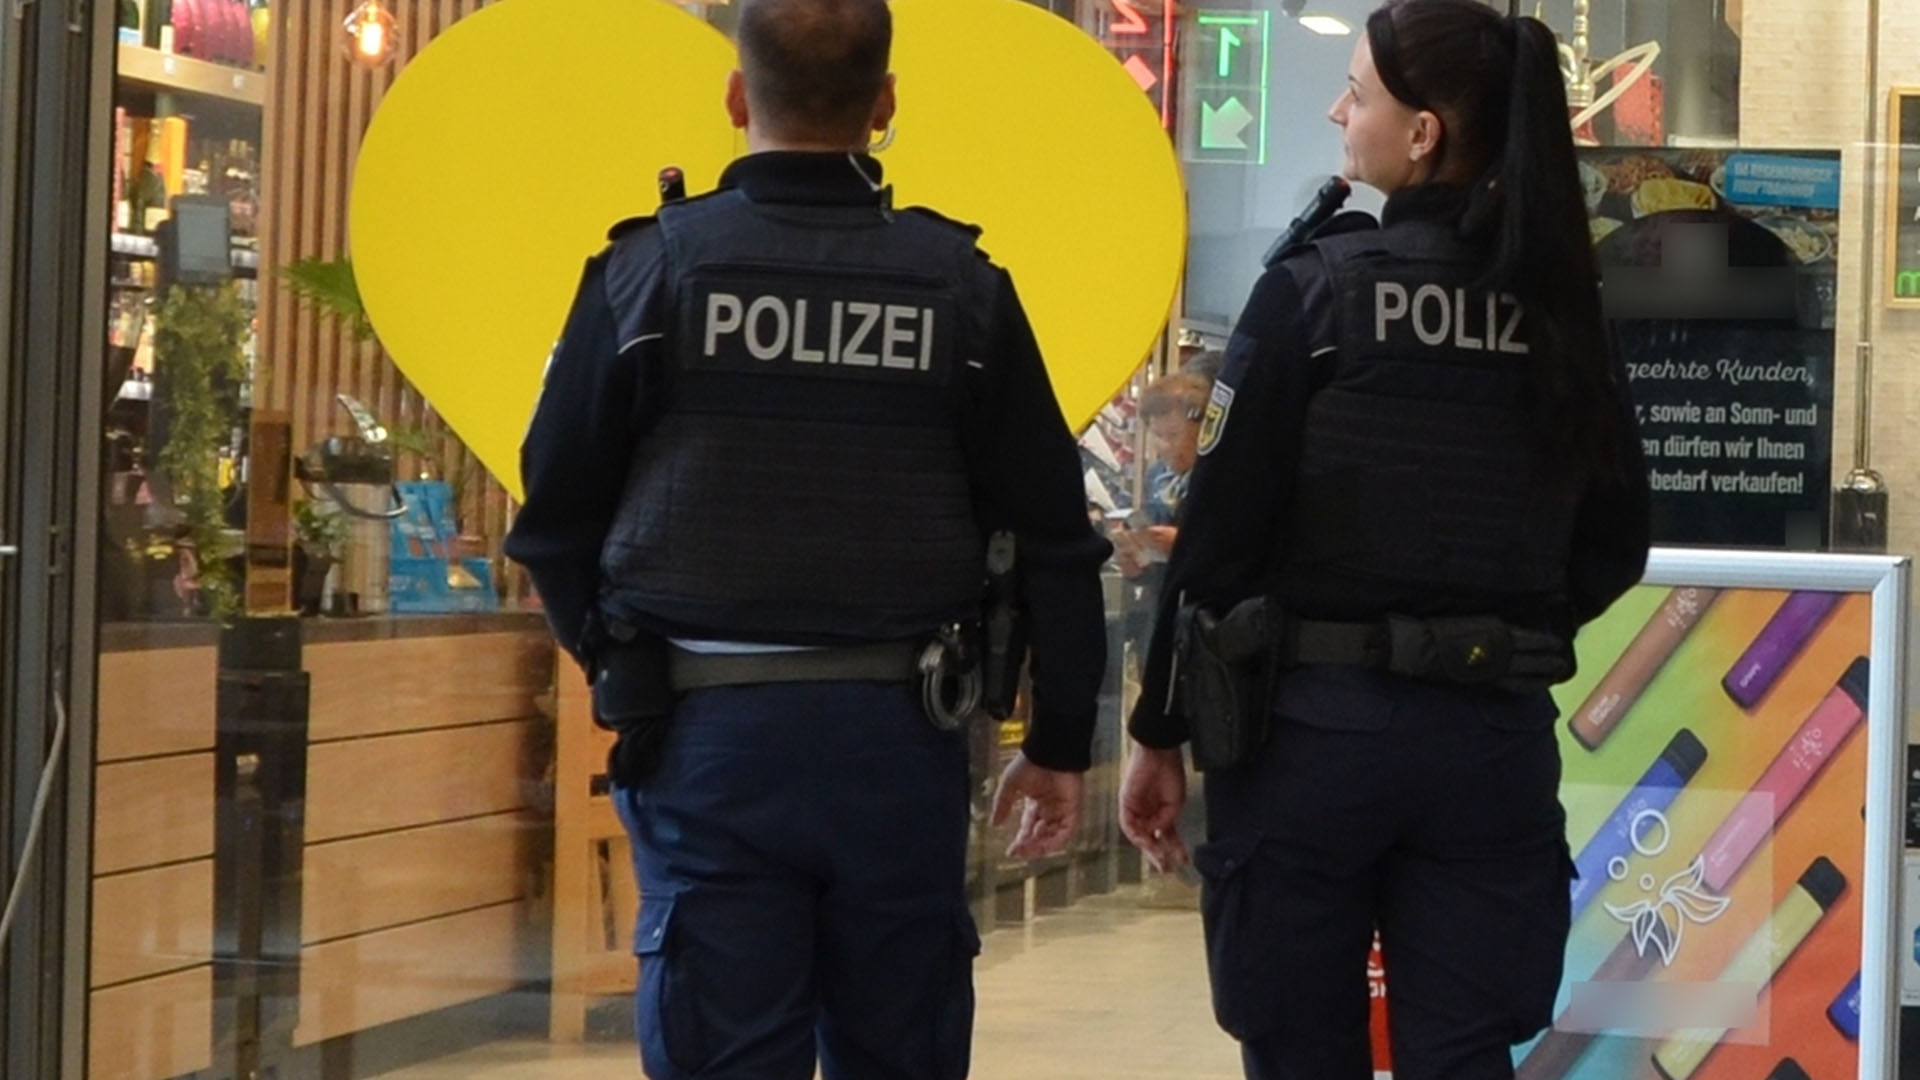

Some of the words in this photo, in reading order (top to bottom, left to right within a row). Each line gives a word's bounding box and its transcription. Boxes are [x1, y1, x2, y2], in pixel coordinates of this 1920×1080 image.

[1375, 282, 1529, 353] POLIZ
[704, 293, 933, 371] POLIZEI
[1716, 358, 1814, 387] Kunden,
[1635, 404, 1646, 426] r,
[1650, 401, 1701, 423] sowie
[1705, 406, 1726, 423] an
[1730, 402, 1780, 425] Sonn-
[1785, 404, 1818, 426] und
[1641, 438, 1660, 456] en
[1664, 434, 1721, 458] dürfen
[1724, 437, 1753, 458] wir
[1757, 437, 1805, 460] Ihnen
[1648, 468, 1709, 492] bedarf
[1711, 471, 1804, 494] verkaufen!
